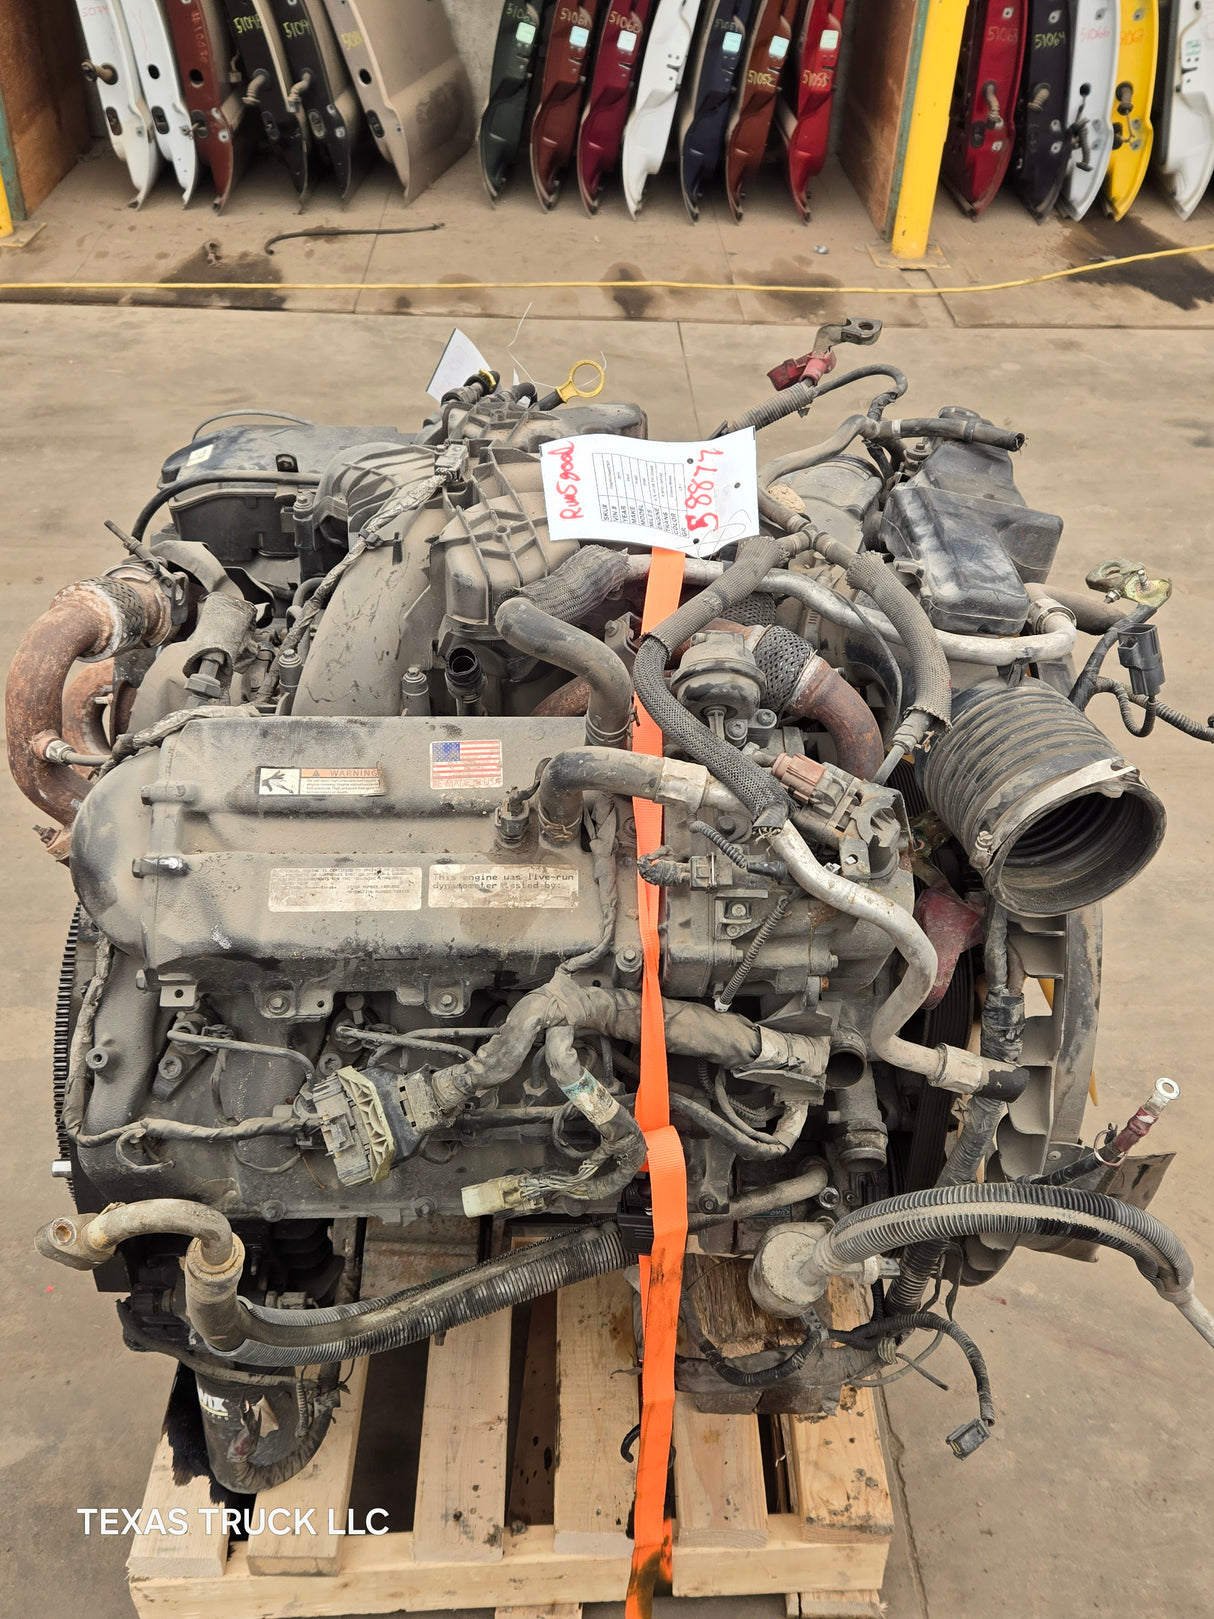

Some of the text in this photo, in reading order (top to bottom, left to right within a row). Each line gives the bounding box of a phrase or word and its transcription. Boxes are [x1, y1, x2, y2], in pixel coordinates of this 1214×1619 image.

[684, 448, 724, 532] 58877
[620, 505, 628, 523] YEAR
[638, 504, 646, 526] MODEL
[671, 512, 679, 535] COLOR
[432, 872, 456, 881] This
[463, 873, 498, 883] engine
[527, 872, 574, 881] live-run
[432, 881, 561, 891] dynamometer tested by:
